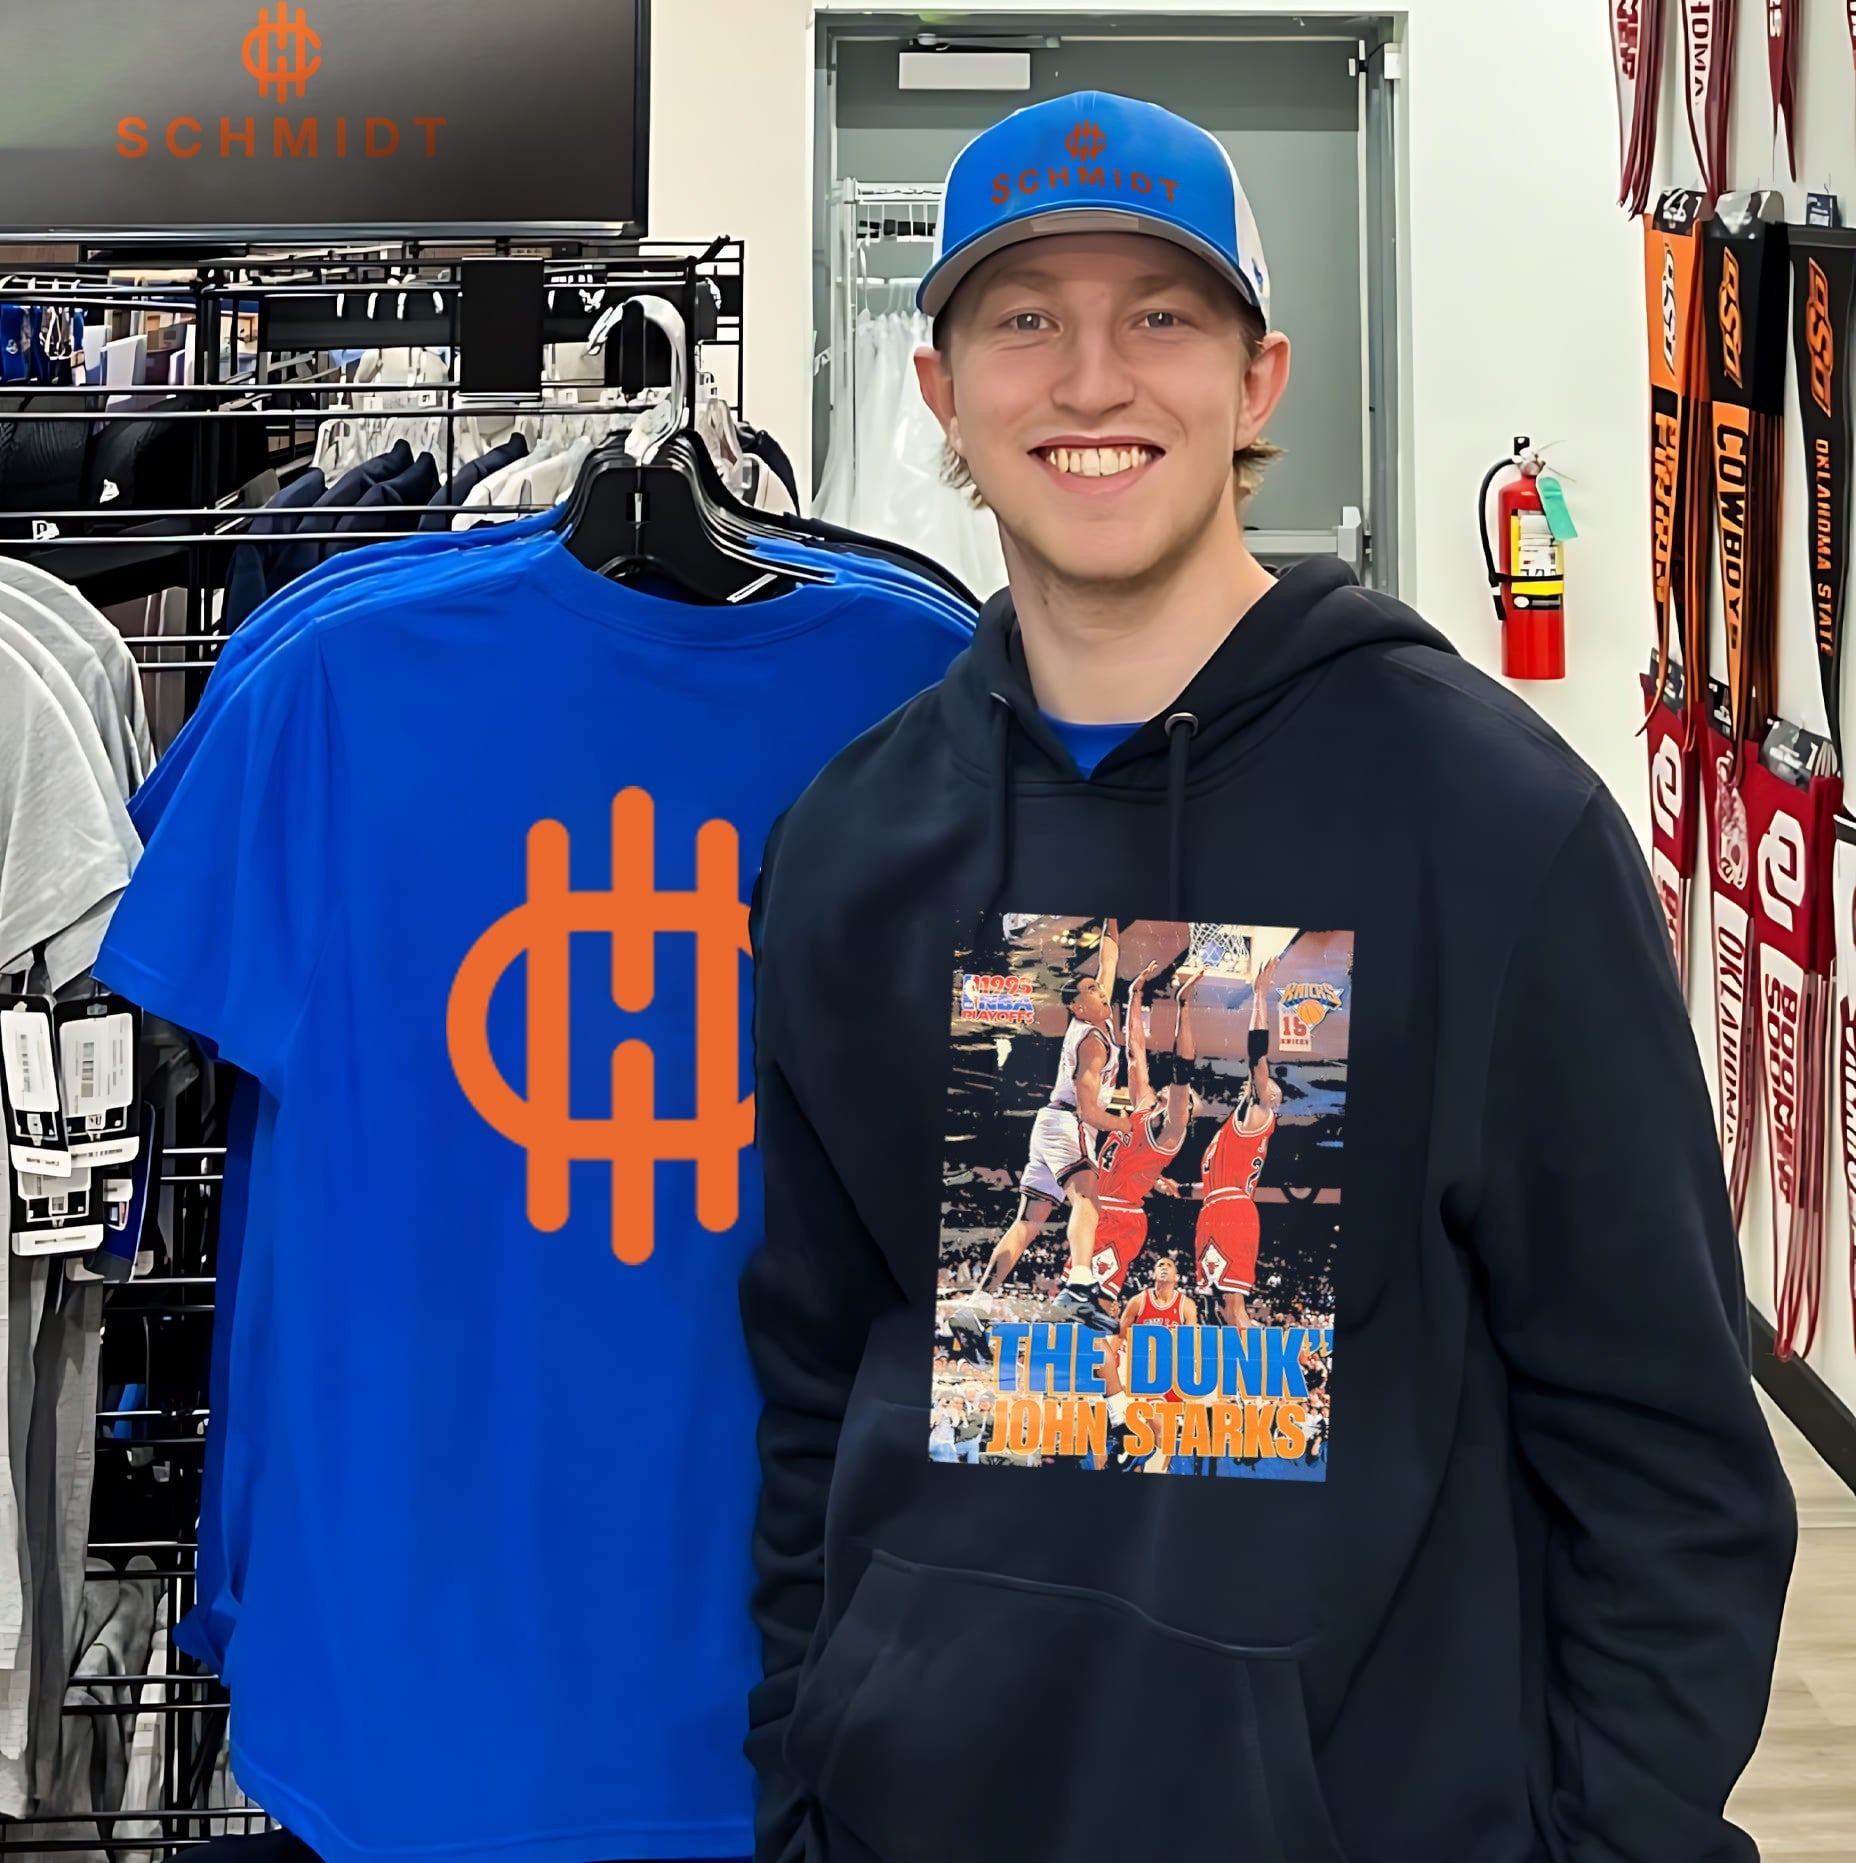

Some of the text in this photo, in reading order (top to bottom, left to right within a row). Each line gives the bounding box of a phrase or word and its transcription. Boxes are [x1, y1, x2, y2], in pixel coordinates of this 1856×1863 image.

[116, 117, 447, 159] SCHMIDT
[992, 167, 1179, 204] SCHMIDT
[979, 975, 1033, 994] 1995
[1280, 983, 1341, 1006] KNICKS
[990, 1321, 1107, 1396] THE
[985, 1399, 1307, 1460] JOHN STARKS
